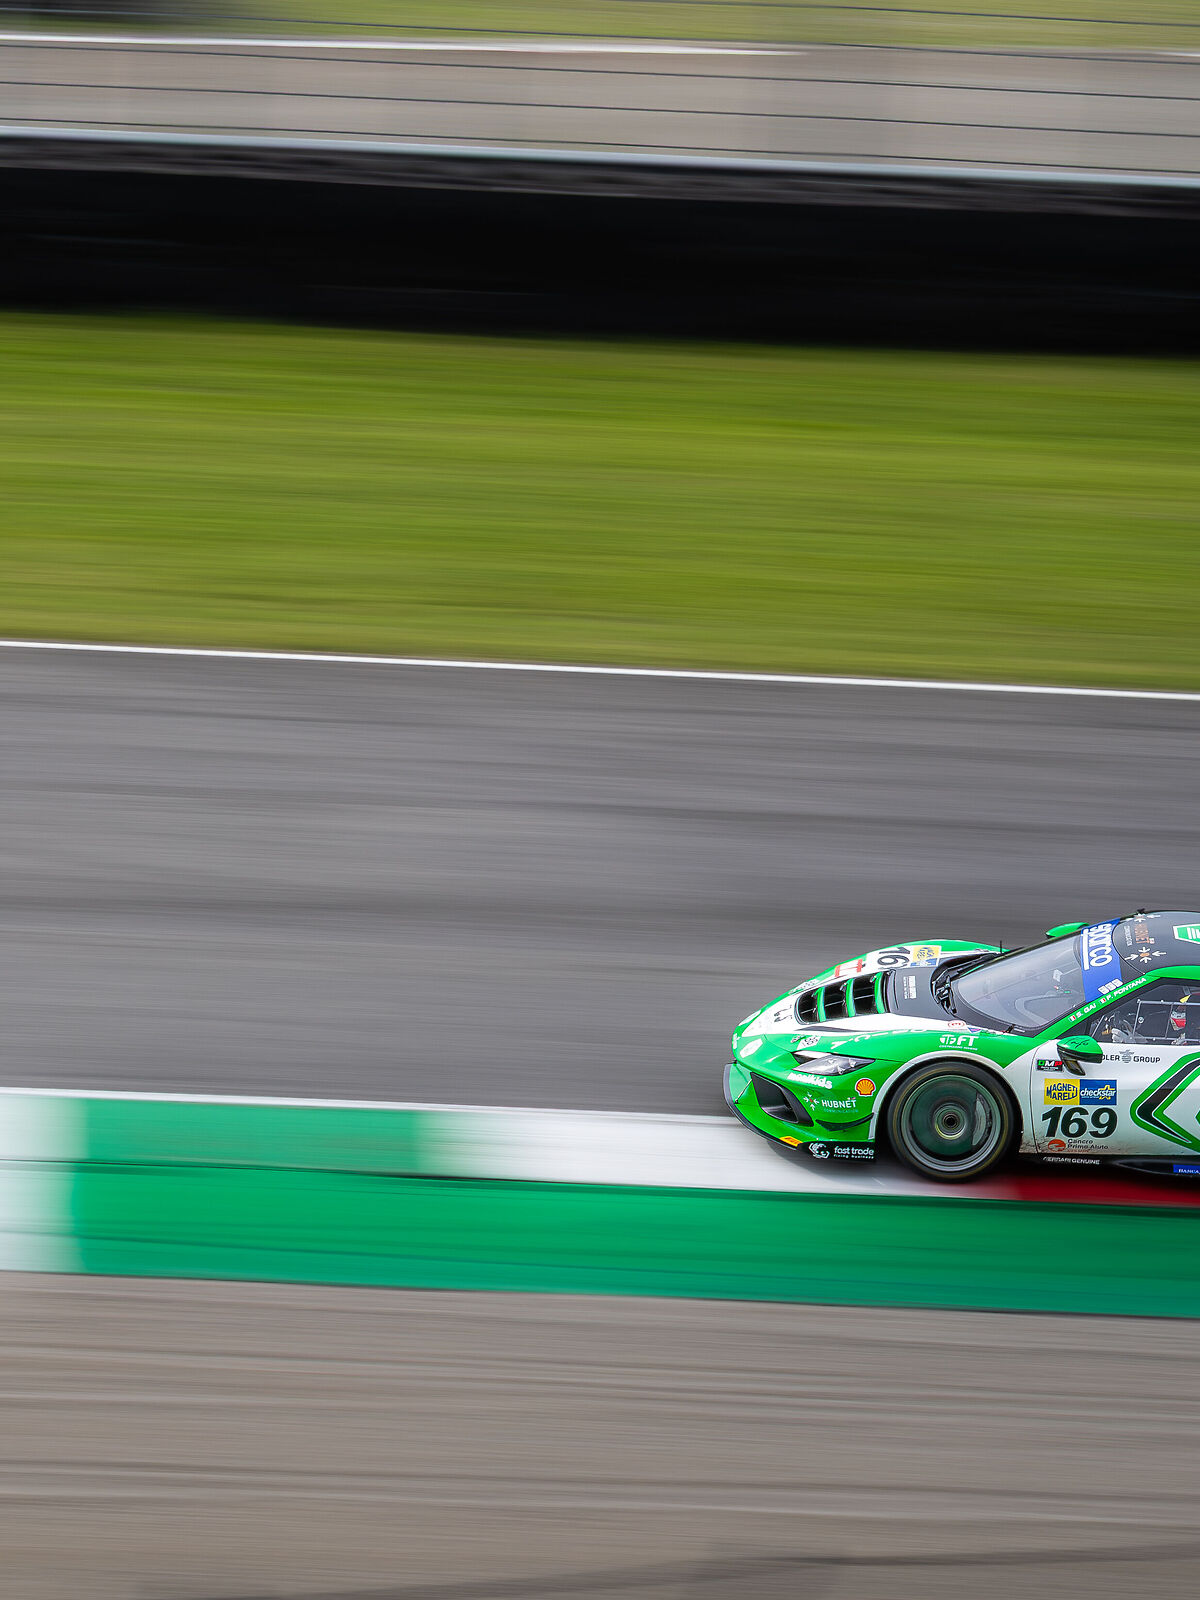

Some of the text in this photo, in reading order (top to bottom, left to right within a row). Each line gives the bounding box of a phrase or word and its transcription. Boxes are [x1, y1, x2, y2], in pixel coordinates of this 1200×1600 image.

[1088, 923, 1113, 967] sparco
[1083, 1003, 1097, 1014] GAI
[1133, 1055, 1161, 1063] GROUP
[1080, 1087, 1117, 1097] checkstar
[821, 1099, 857, 1108] HUBNET
[1041, 1106, 1118, 1138] 169
[834, 1145, 875, 1156] fast trade
